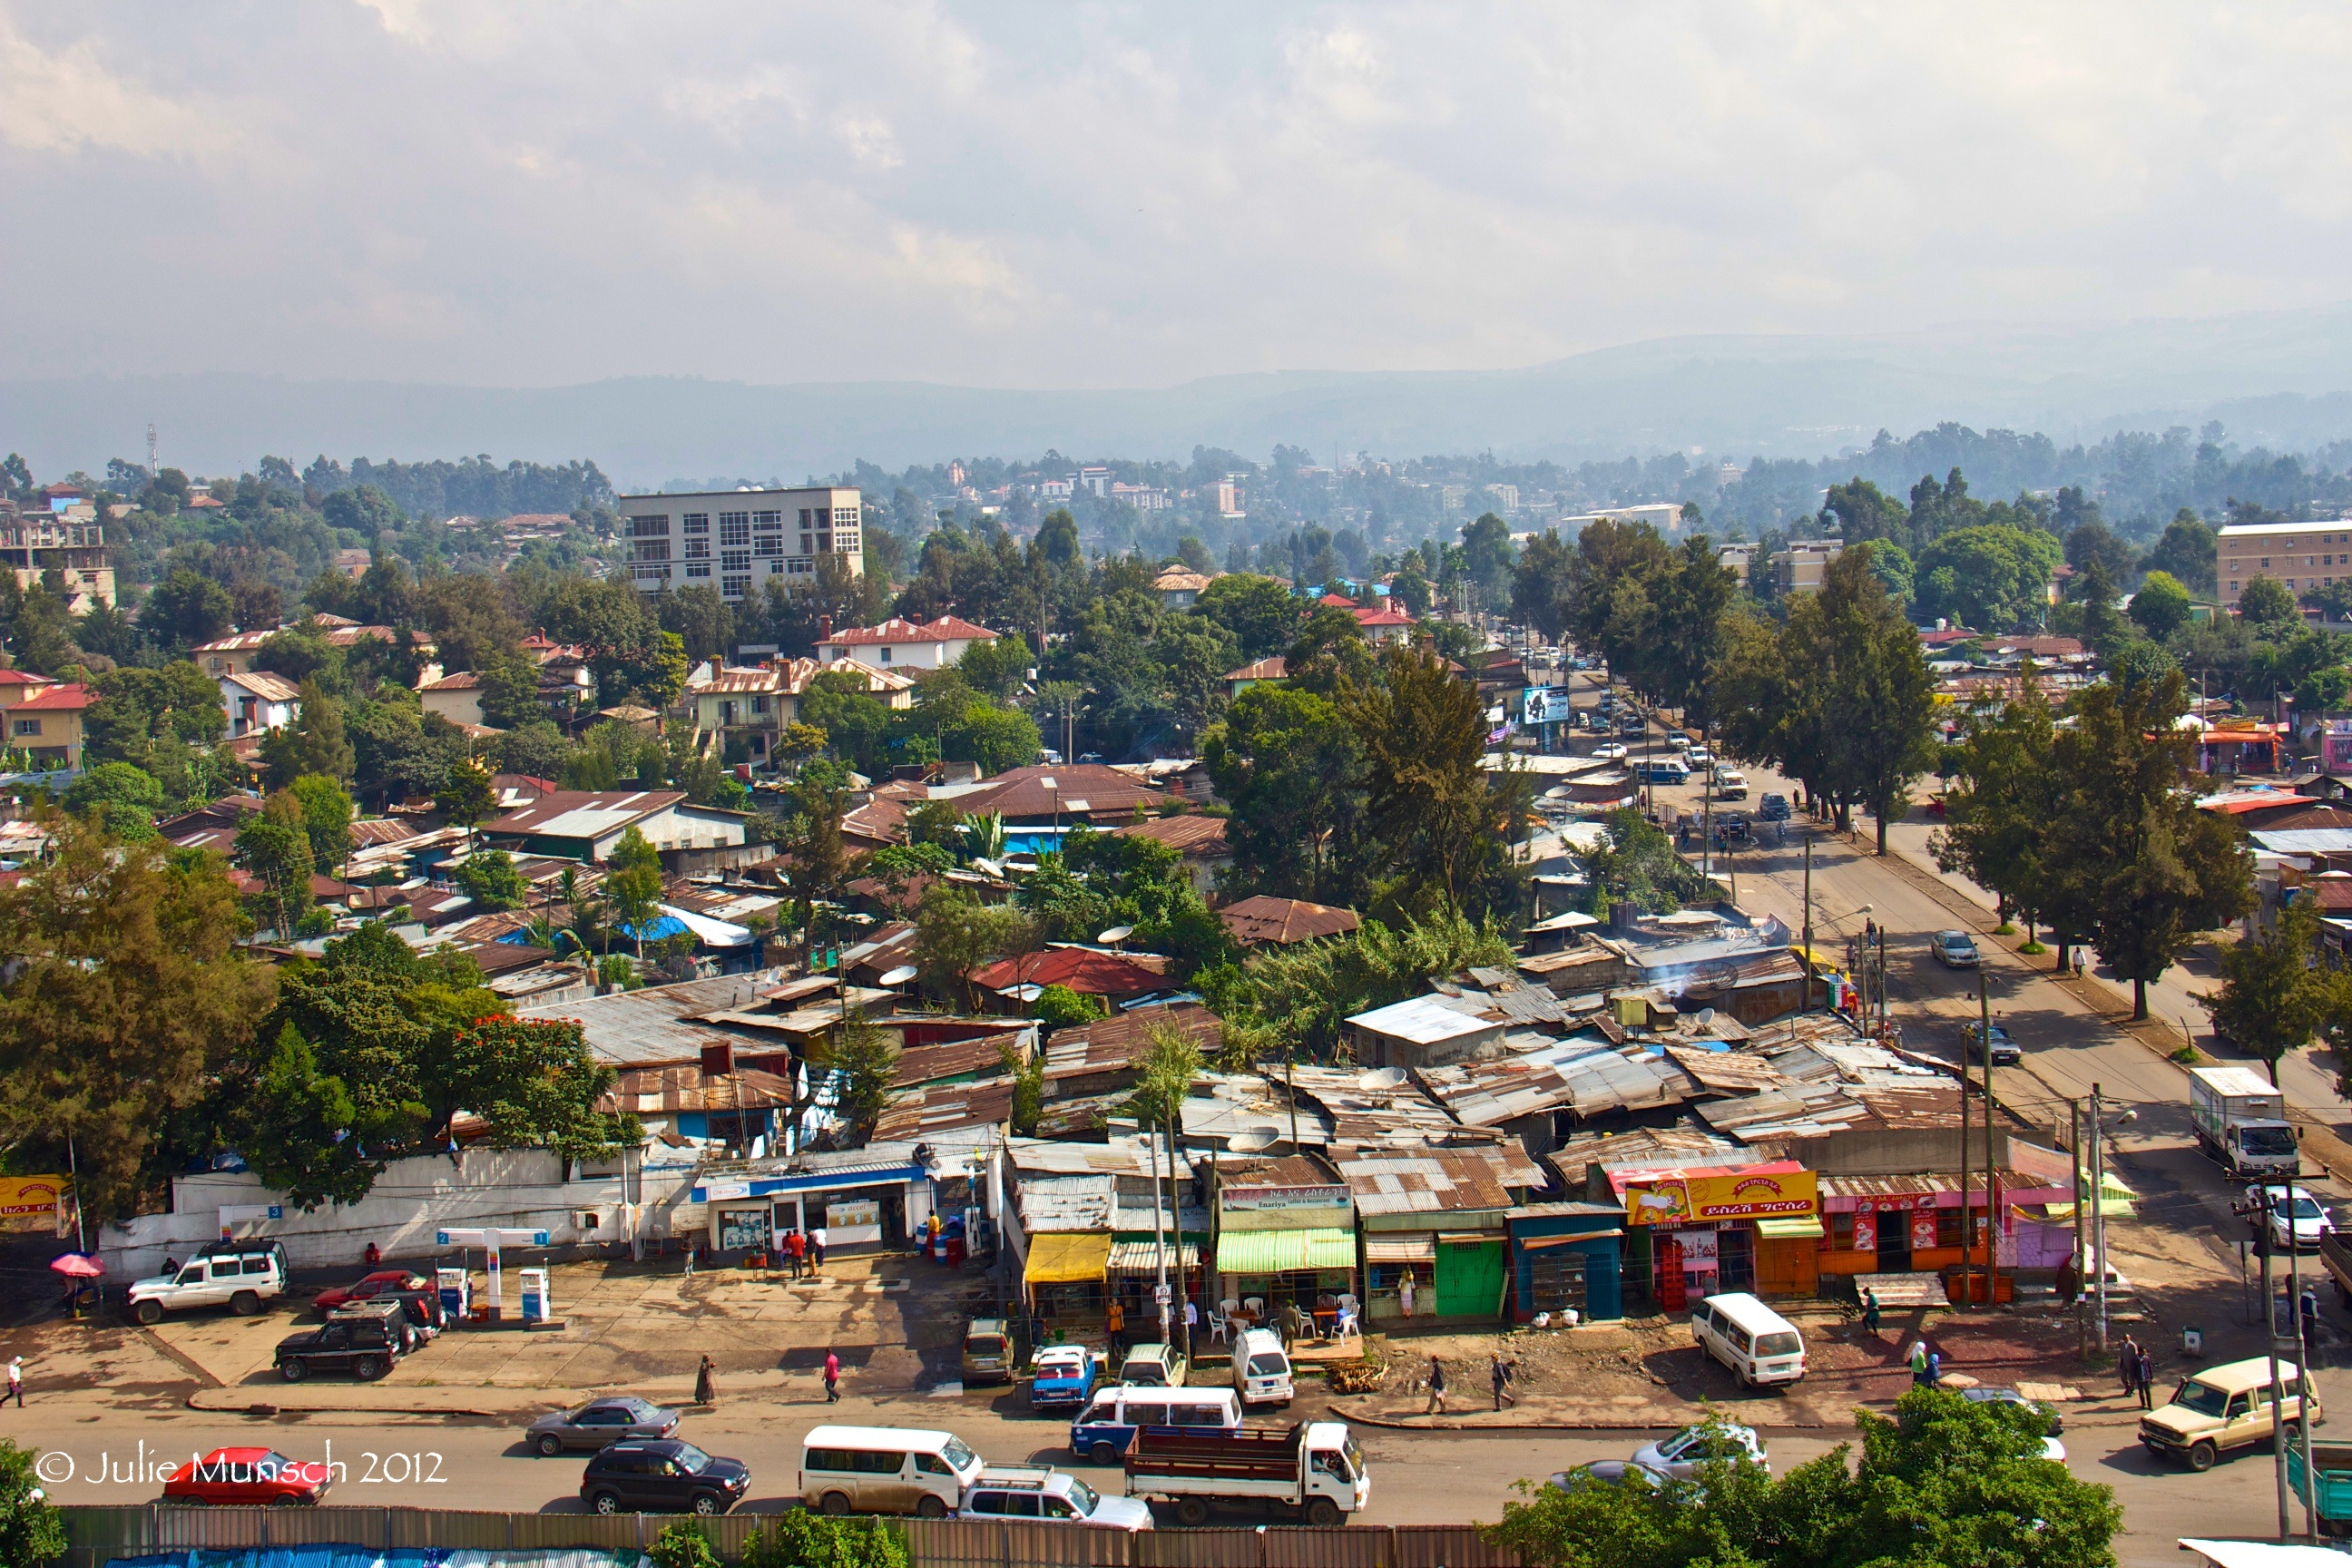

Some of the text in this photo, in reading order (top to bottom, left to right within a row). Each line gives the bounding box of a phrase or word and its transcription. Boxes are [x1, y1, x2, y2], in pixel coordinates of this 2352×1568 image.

[272, 1208, 279, 1216] 3
[440, 1234, 446, 1242] 2
[538, 1234, 544, 1242] 1
